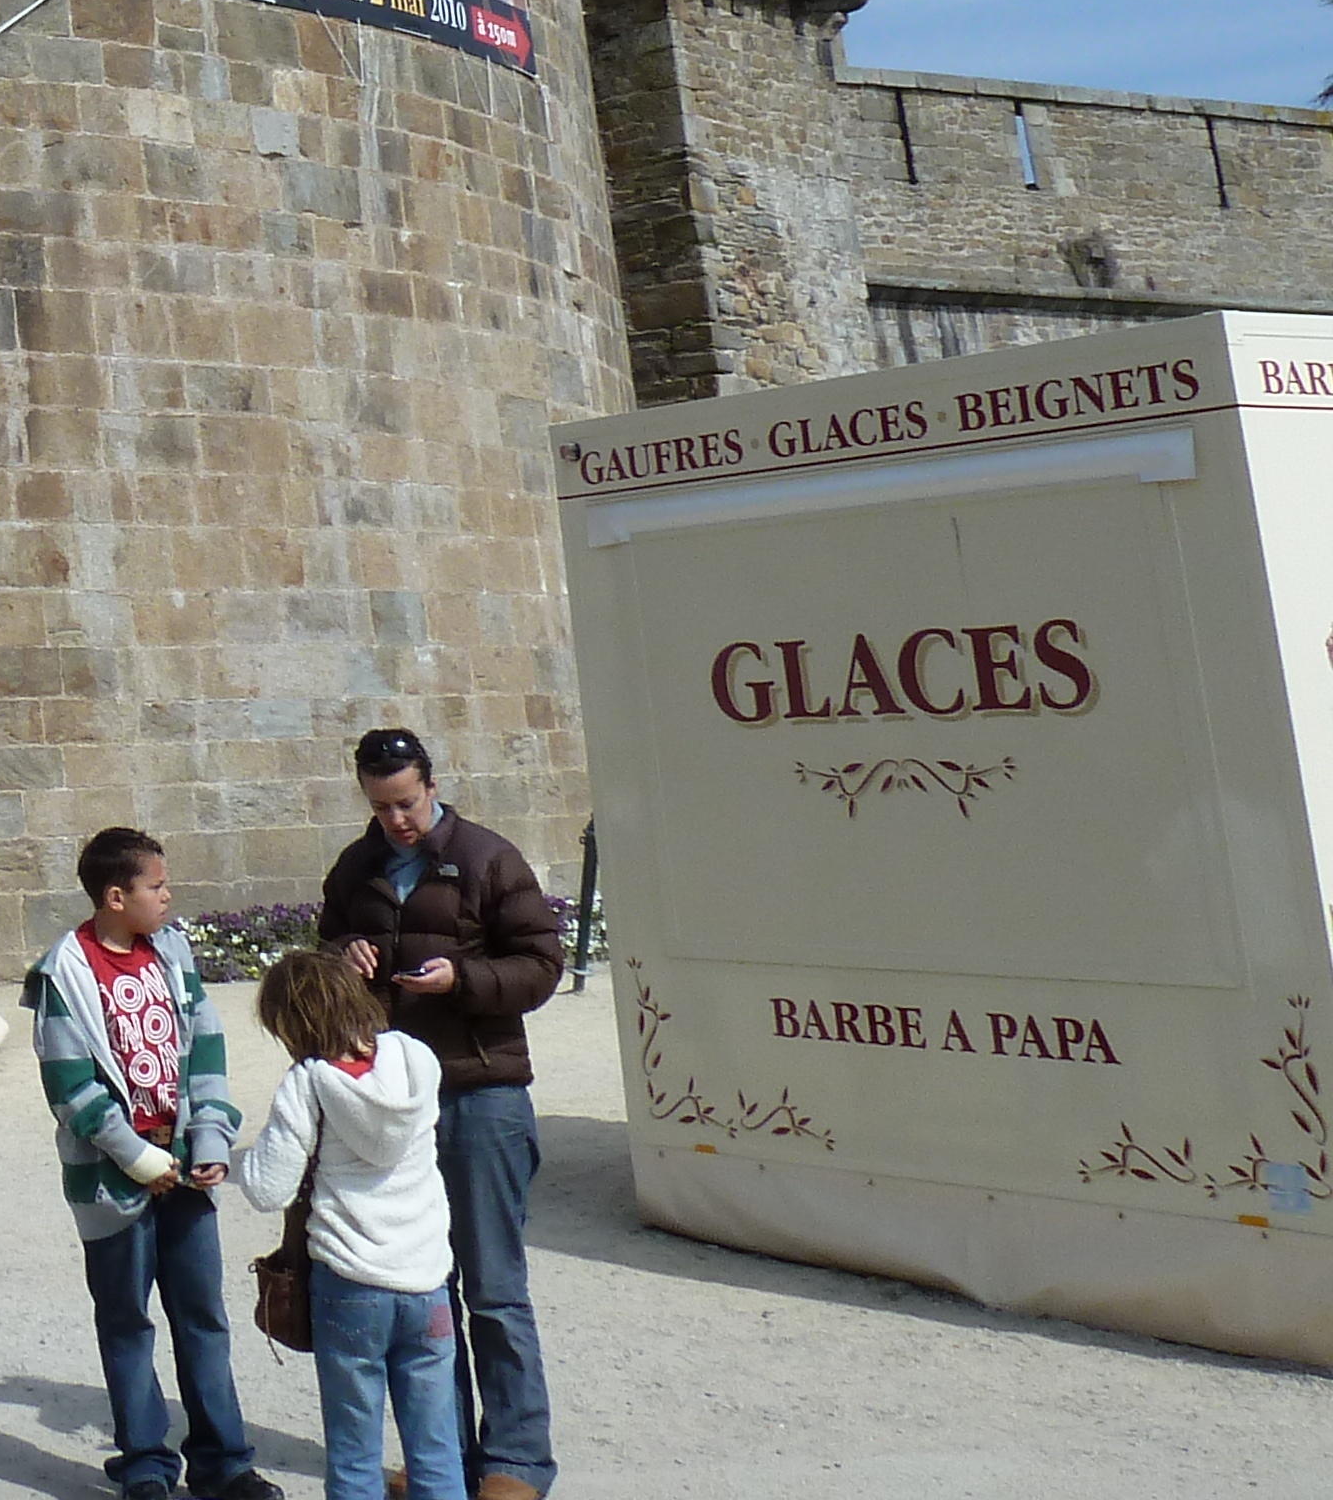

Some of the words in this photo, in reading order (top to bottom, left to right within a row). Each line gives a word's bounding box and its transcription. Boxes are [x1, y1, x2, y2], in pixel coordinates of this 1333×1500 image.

[477, 11, 485, 36] à
[488, 22, 517, 48] 150m
[580, 429, 743, 486] GAUFRES
[768, 400, 928, 458] GLACES
[953, 359, 1200, 432] BEIGNETS
[711, 618, 1096, 726] GLACES
[769, 997, 926, 1049] BARBE
[941, 1009, 977, 1053] A
[986, 1012, 1121, 1065] PAPA
